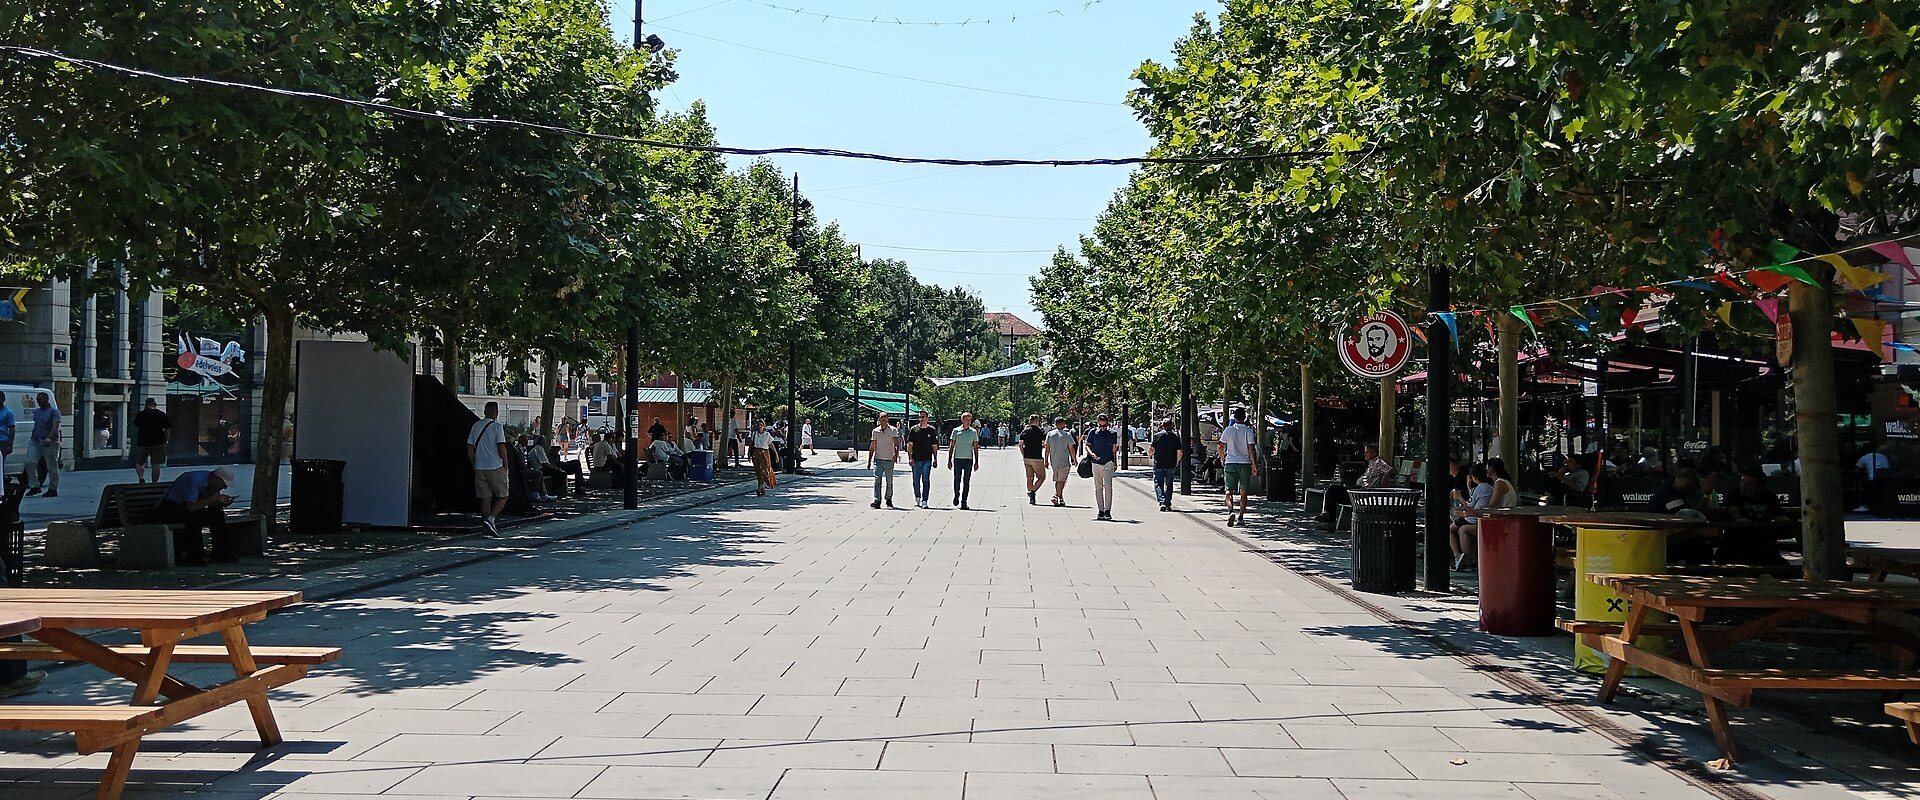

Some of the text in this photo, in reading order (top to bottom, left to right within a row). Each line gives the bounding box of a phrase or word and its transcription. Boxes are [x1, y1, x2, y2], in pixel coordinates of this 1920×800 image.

[195, 358, 222, 374] edelweiss
[1365, 362, 1390, 371] Coffe
[1622, 492, 1655, 501] walker'
